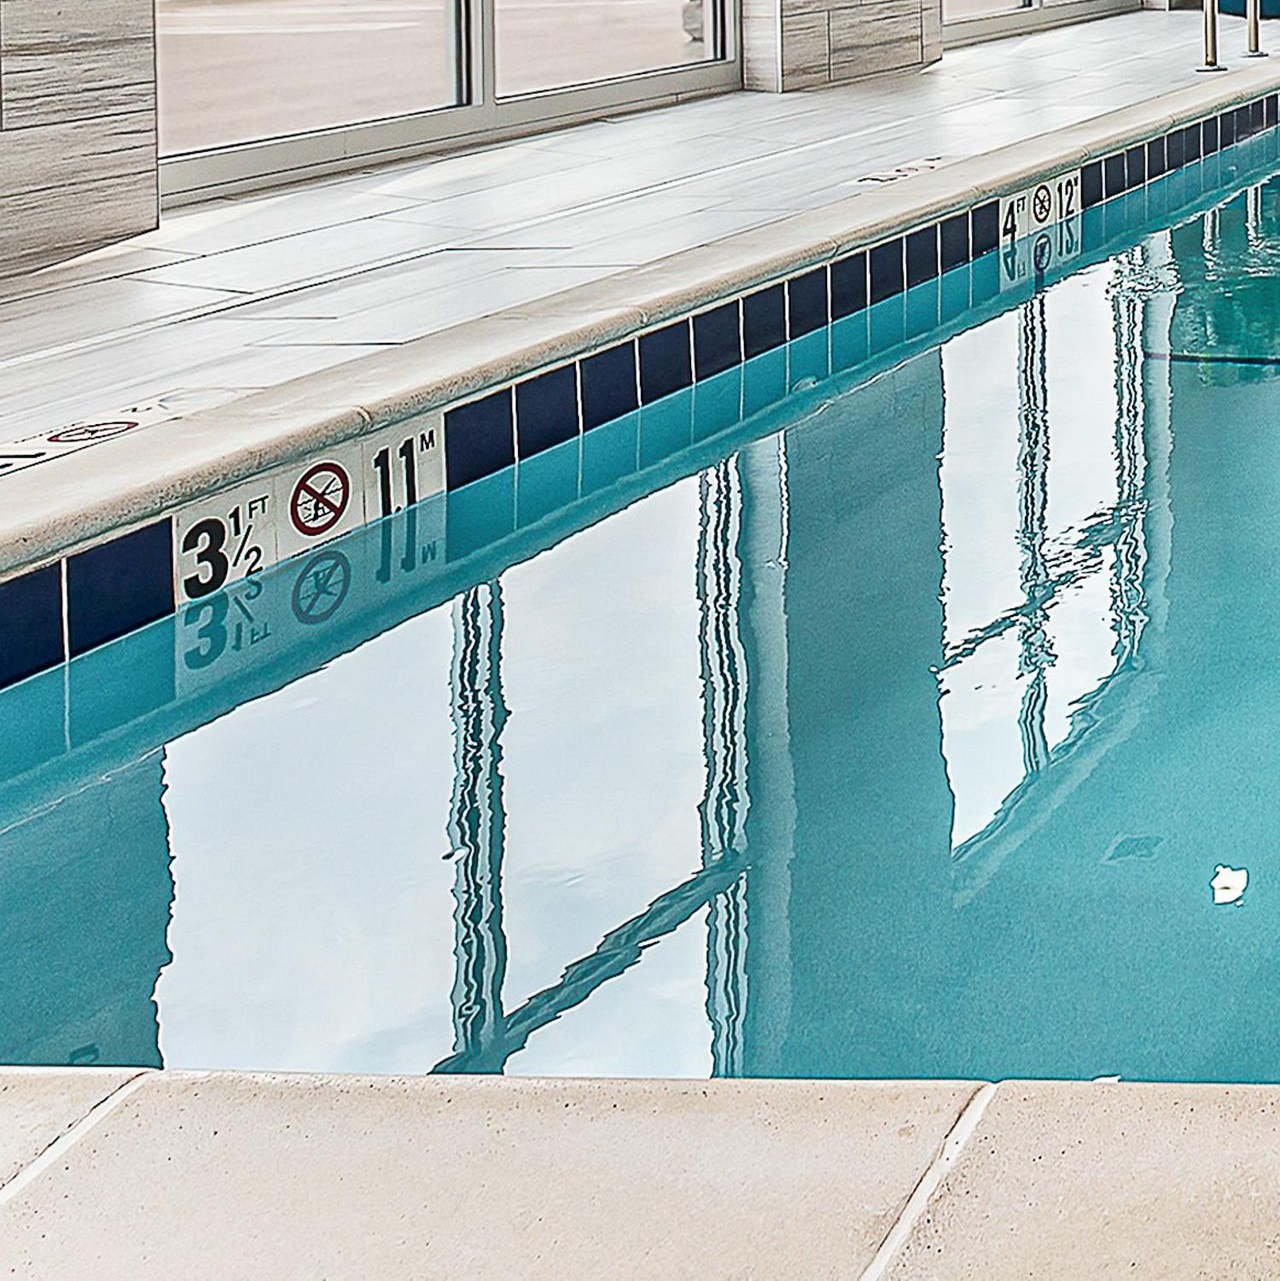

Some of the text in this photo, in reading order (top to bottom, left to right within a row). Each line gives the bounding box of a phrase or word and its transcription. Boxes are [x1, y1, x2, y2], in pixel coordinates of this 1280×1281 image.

[1003, 195, 1026, 243] 4 FT
[419, 429, 436, 452] M
[181, 517, 229, 600] 3
[248, 494, 270, 519] FT
